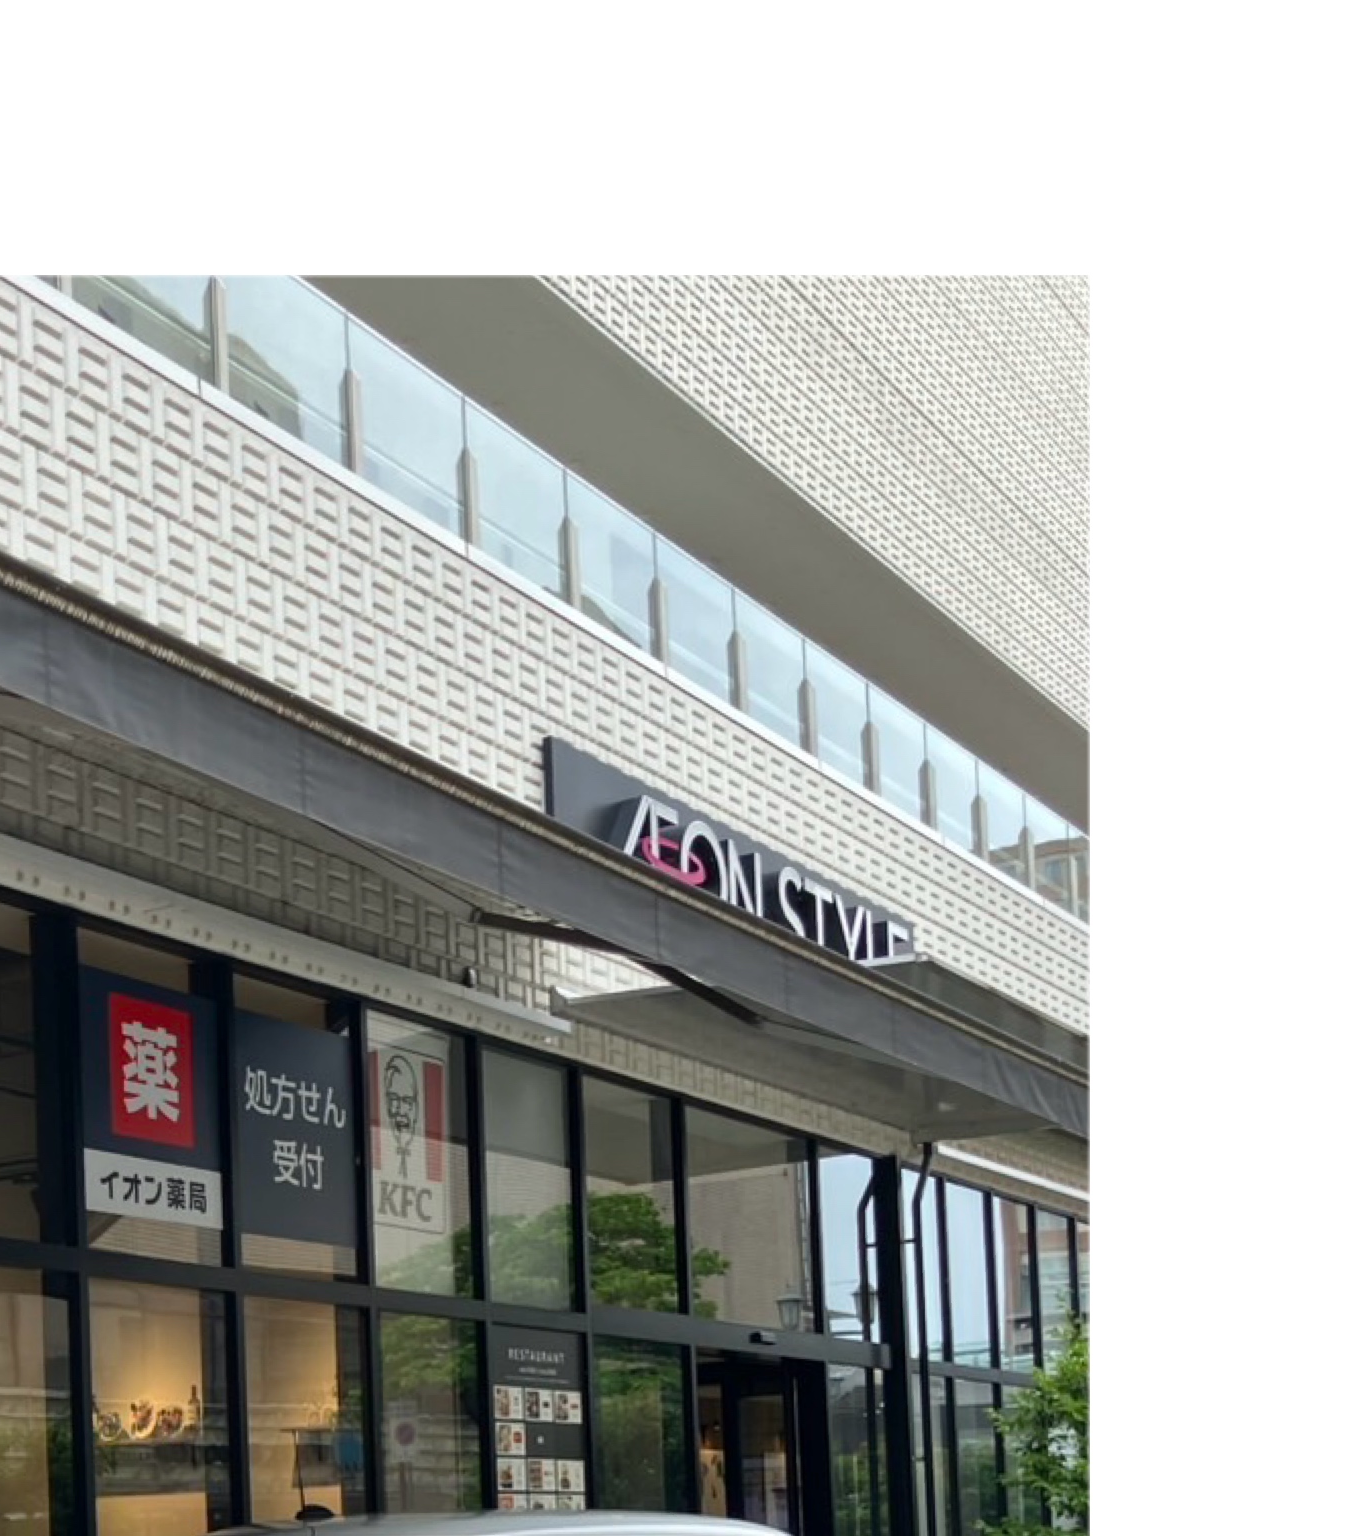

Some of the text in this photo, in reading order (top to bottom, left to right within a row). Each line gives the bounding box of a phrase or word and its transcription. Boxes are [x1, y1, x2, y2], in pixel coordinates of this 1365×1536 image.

[121, 1021, 180, 1123] 薬
[243, 1065, 347, 1129] 処方せん
[272, 1139, 324, 1191] 受付
[99, 1171, 207, 1213] イオン薬局
[377, 1180, 432, 1223] KFC
